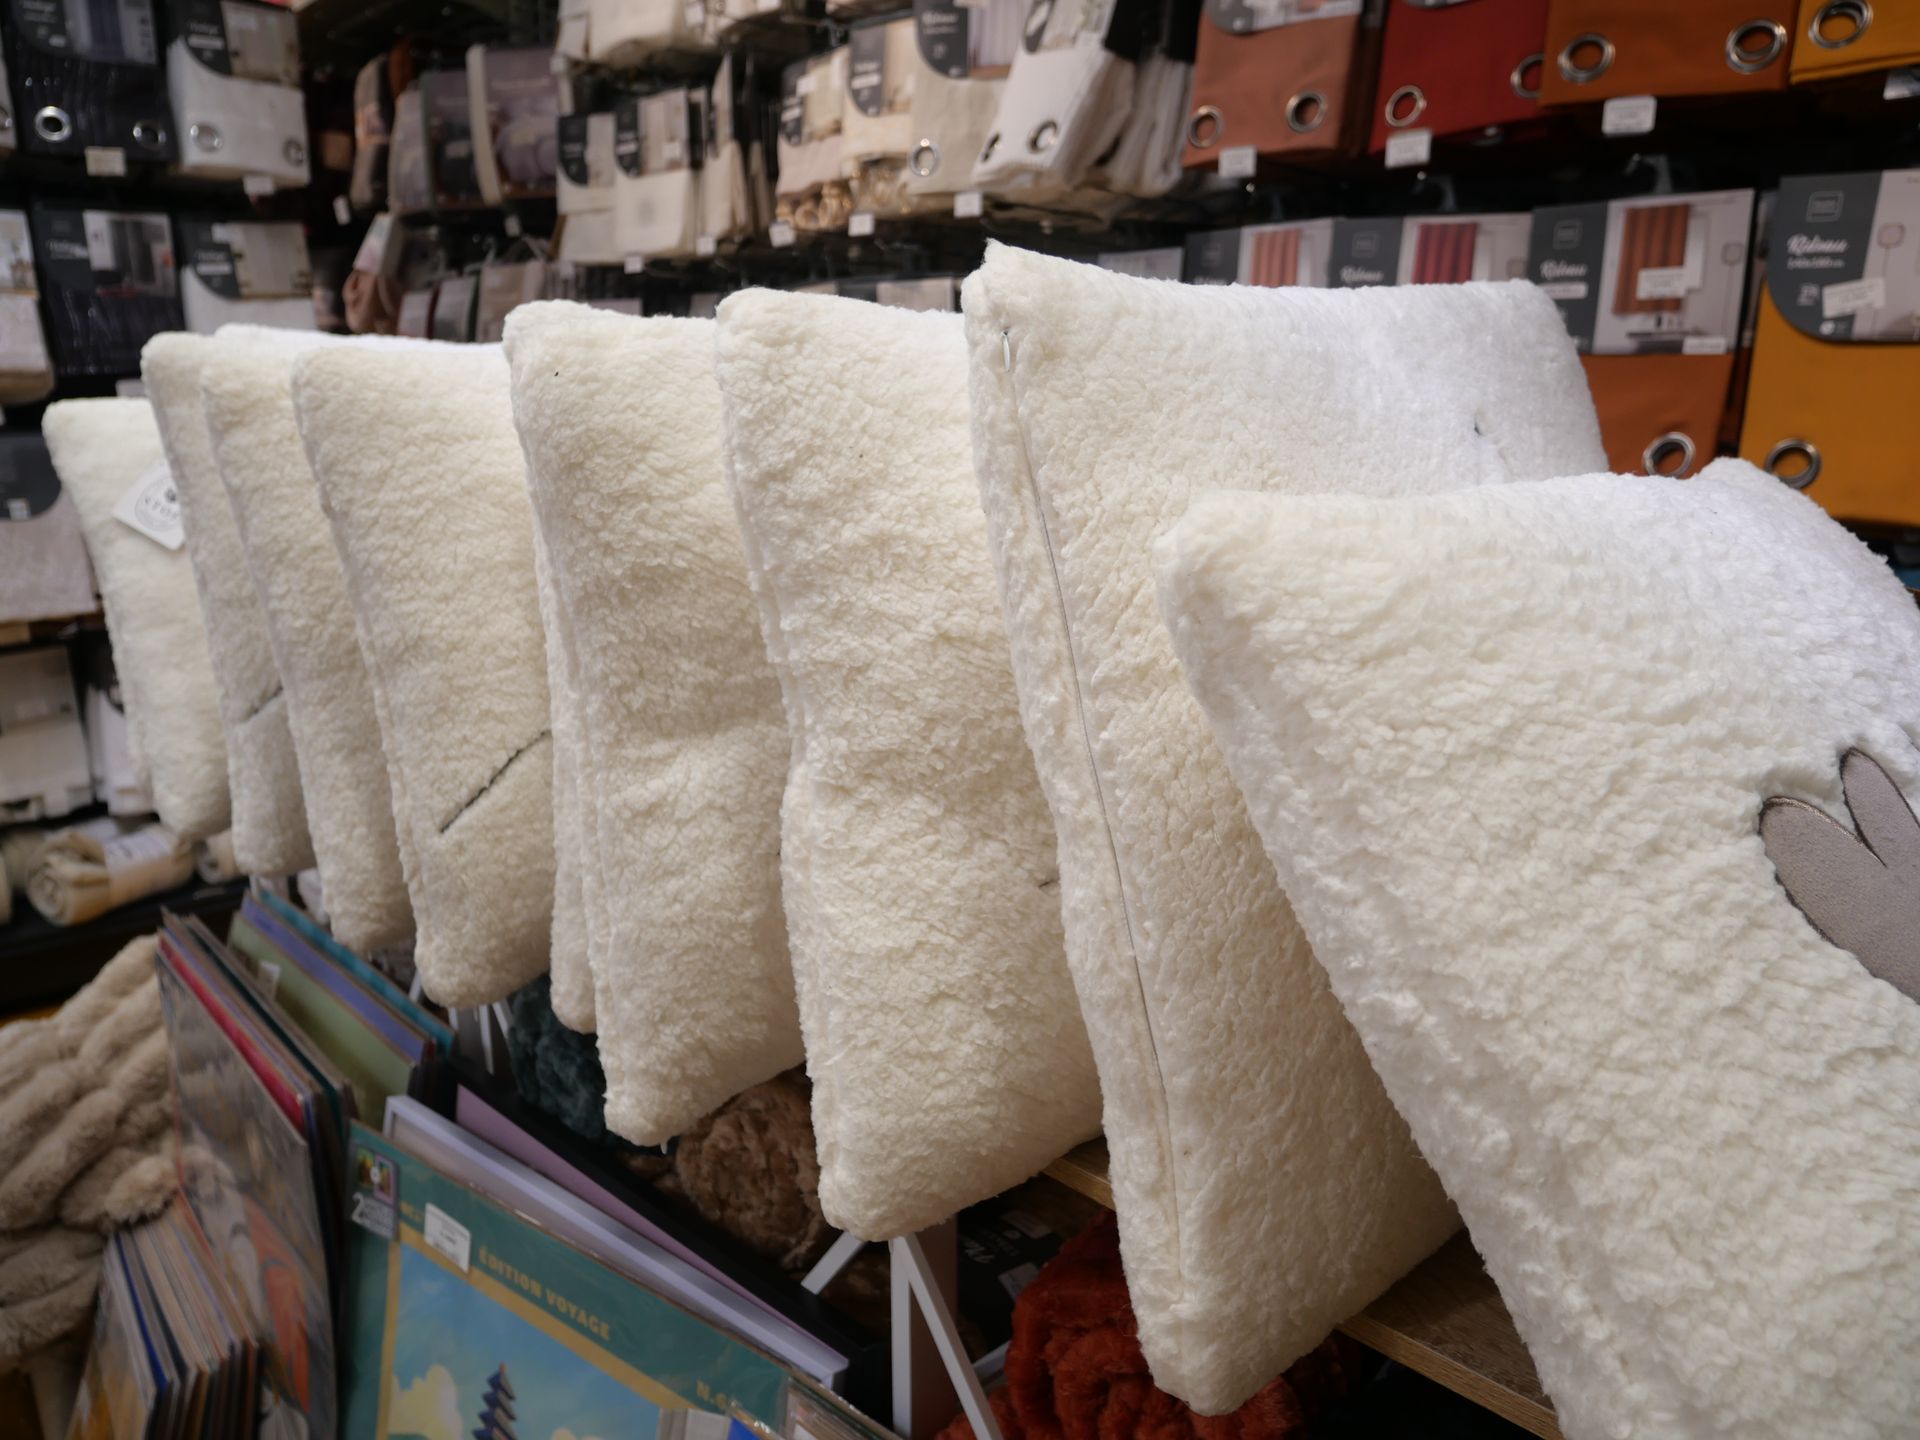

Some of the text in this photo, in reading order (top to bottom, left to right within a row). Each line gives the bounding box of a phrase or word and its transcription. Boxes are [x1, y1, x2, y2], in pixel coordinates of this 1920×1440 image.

[1787, 234, 1848, 256] Rideau
[479, 1244, 610, 1341] ÉDITION VOYAGE
